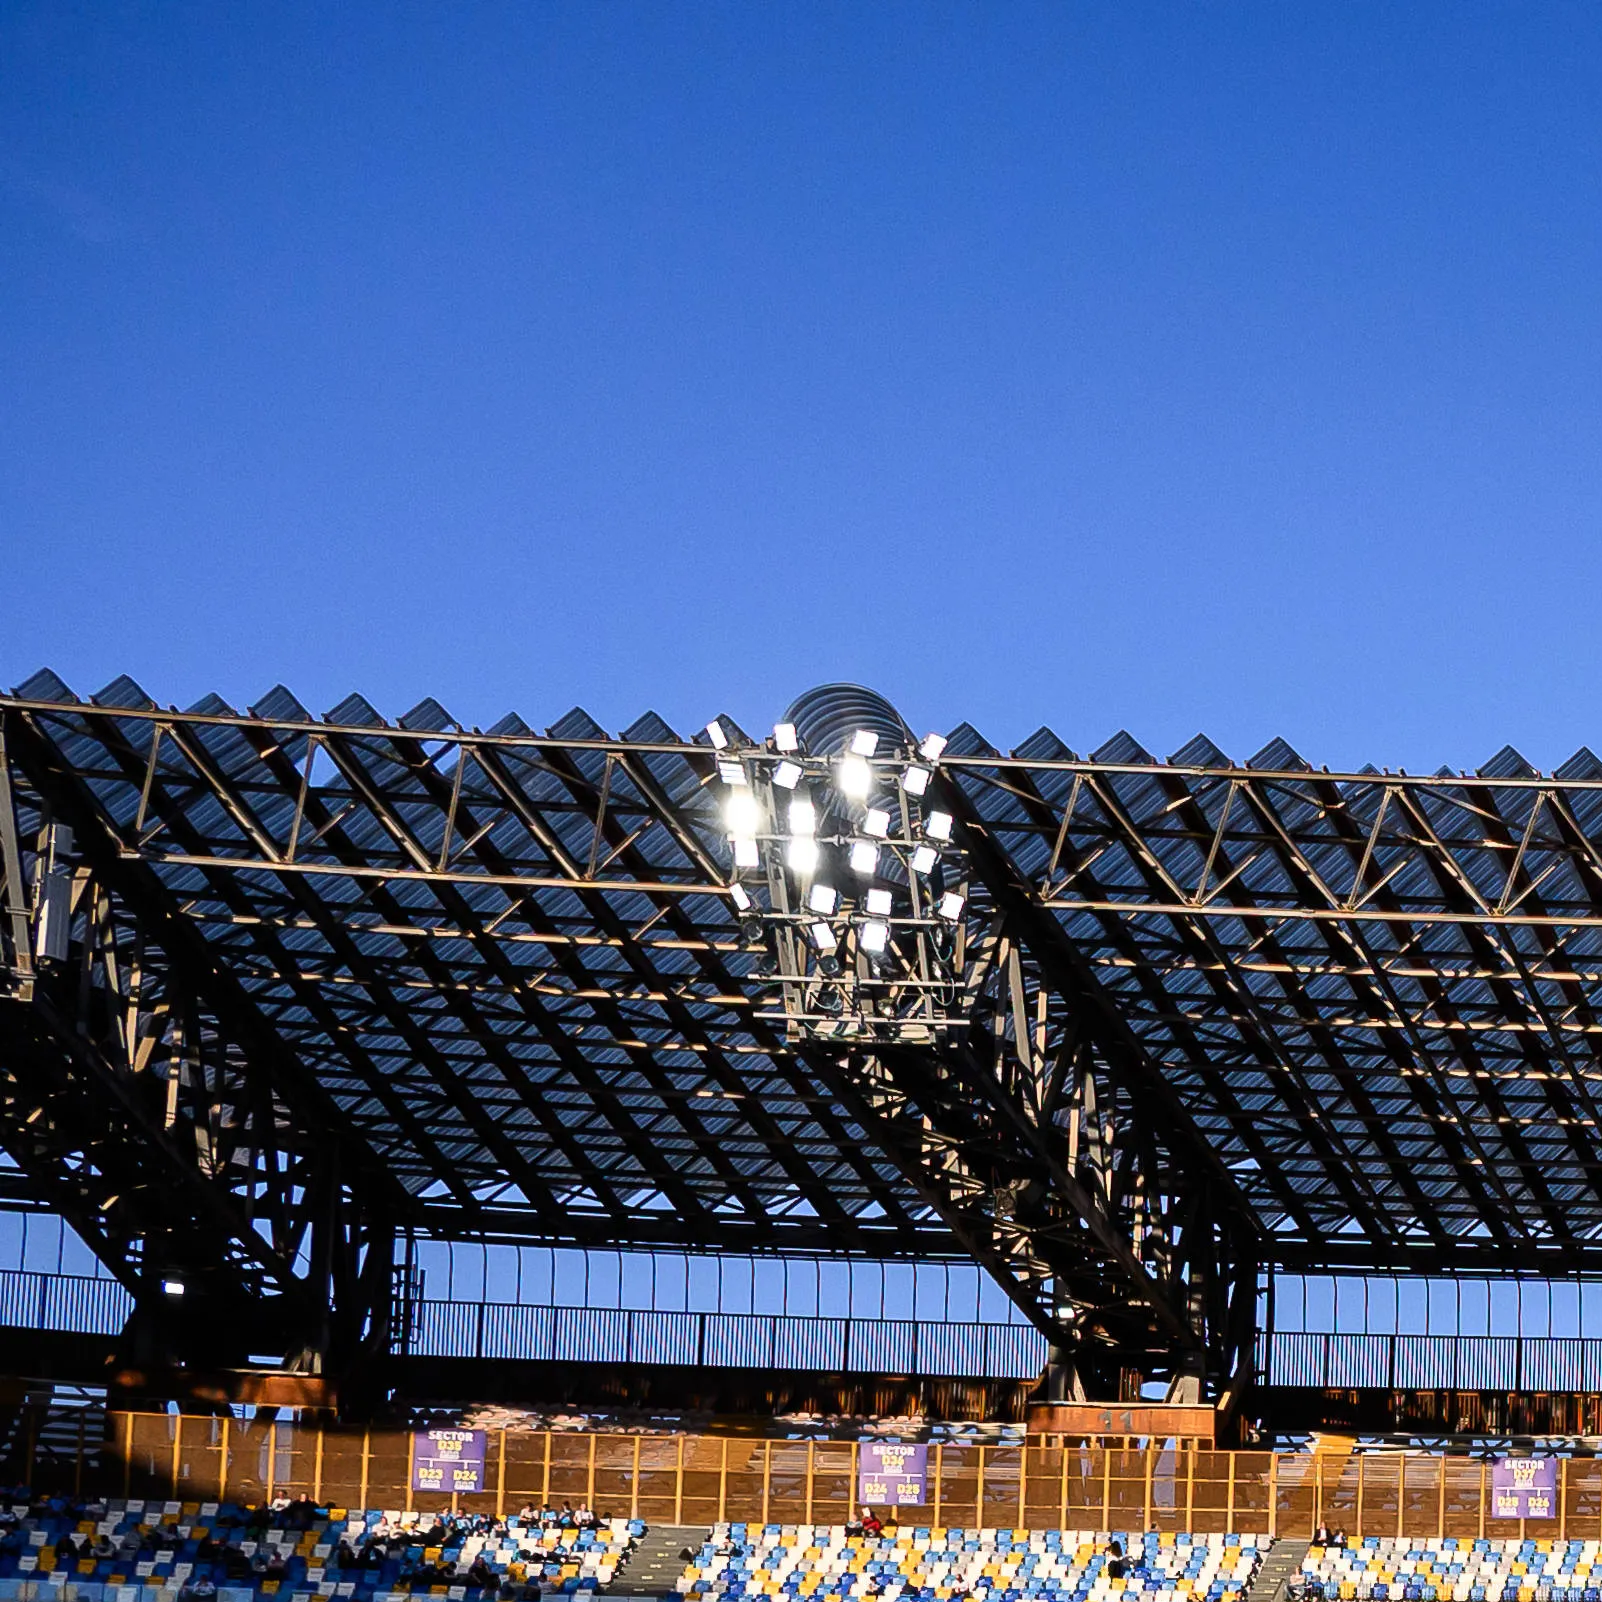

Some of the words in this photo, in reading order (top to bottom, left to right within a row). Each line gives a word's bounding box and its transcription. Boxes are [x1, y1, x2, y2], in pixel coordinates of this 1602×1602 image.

[1100, 1409, 1133, 1432] 11
[428, 1431, 474, 1442] SECTOR
[872, 1445, 915, 1457] SECTOR
[1504, 1459, 1545, 1470] SECTOR
